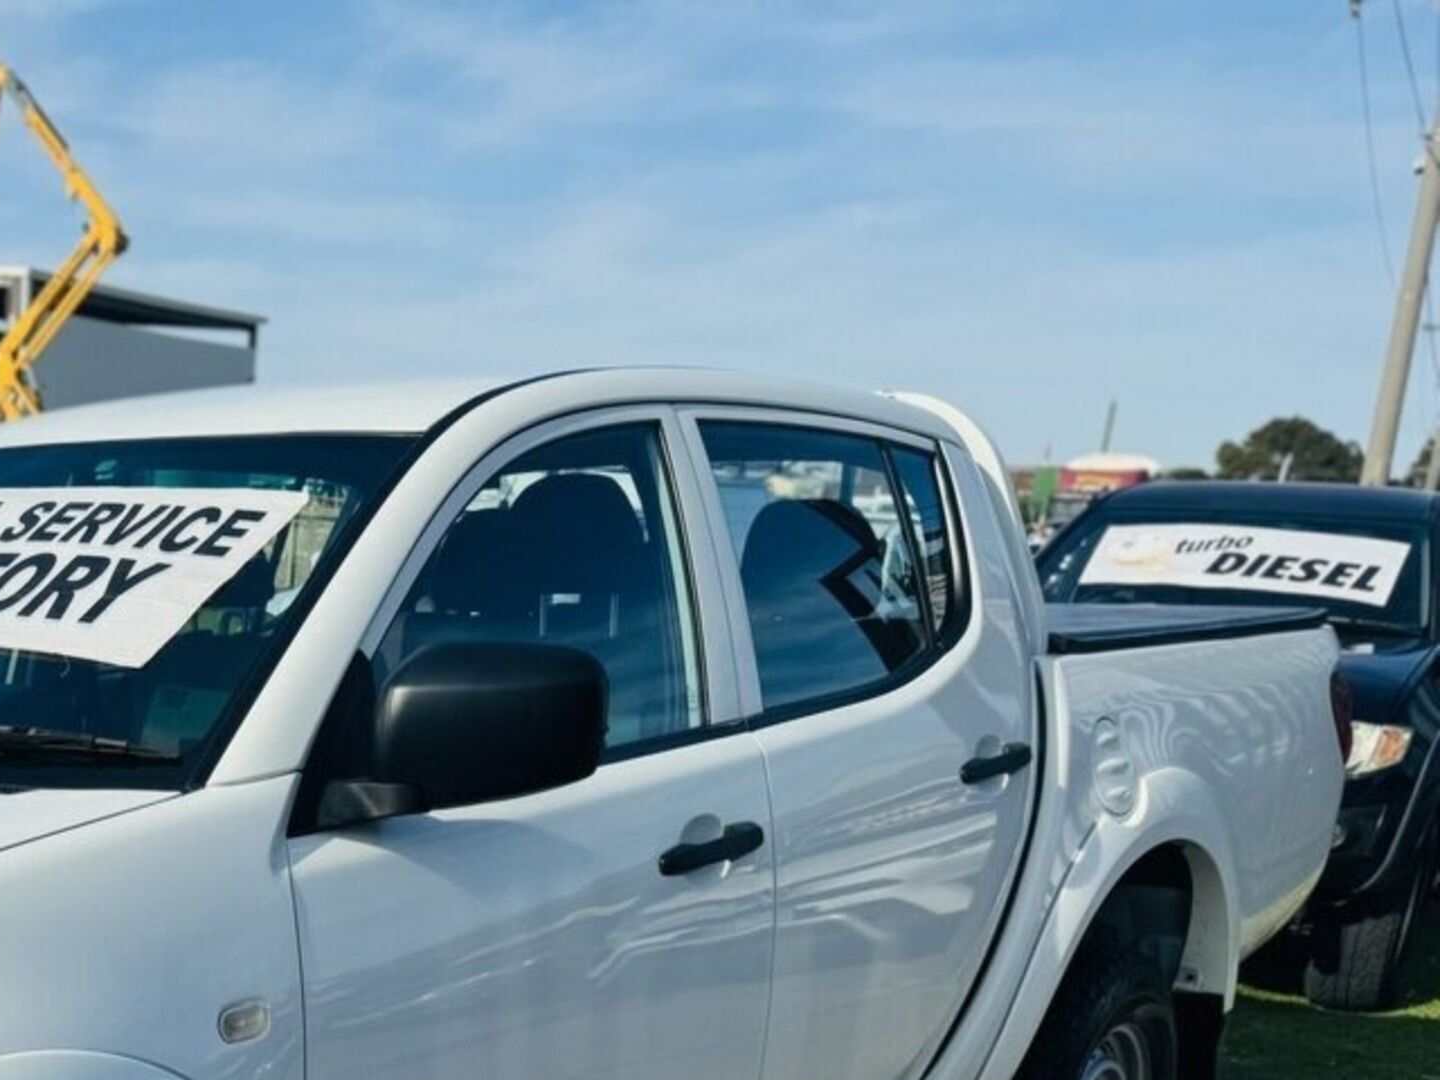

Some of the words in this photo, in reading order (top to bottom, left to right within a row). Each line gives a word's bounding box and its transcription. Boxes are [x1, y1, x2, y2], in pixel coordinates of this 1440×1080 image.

[1, 502, 266, 558] SERVICE
[1174, 535, 1254, 555] turbo
[1205, 552, 1381, 593] DIESEL
